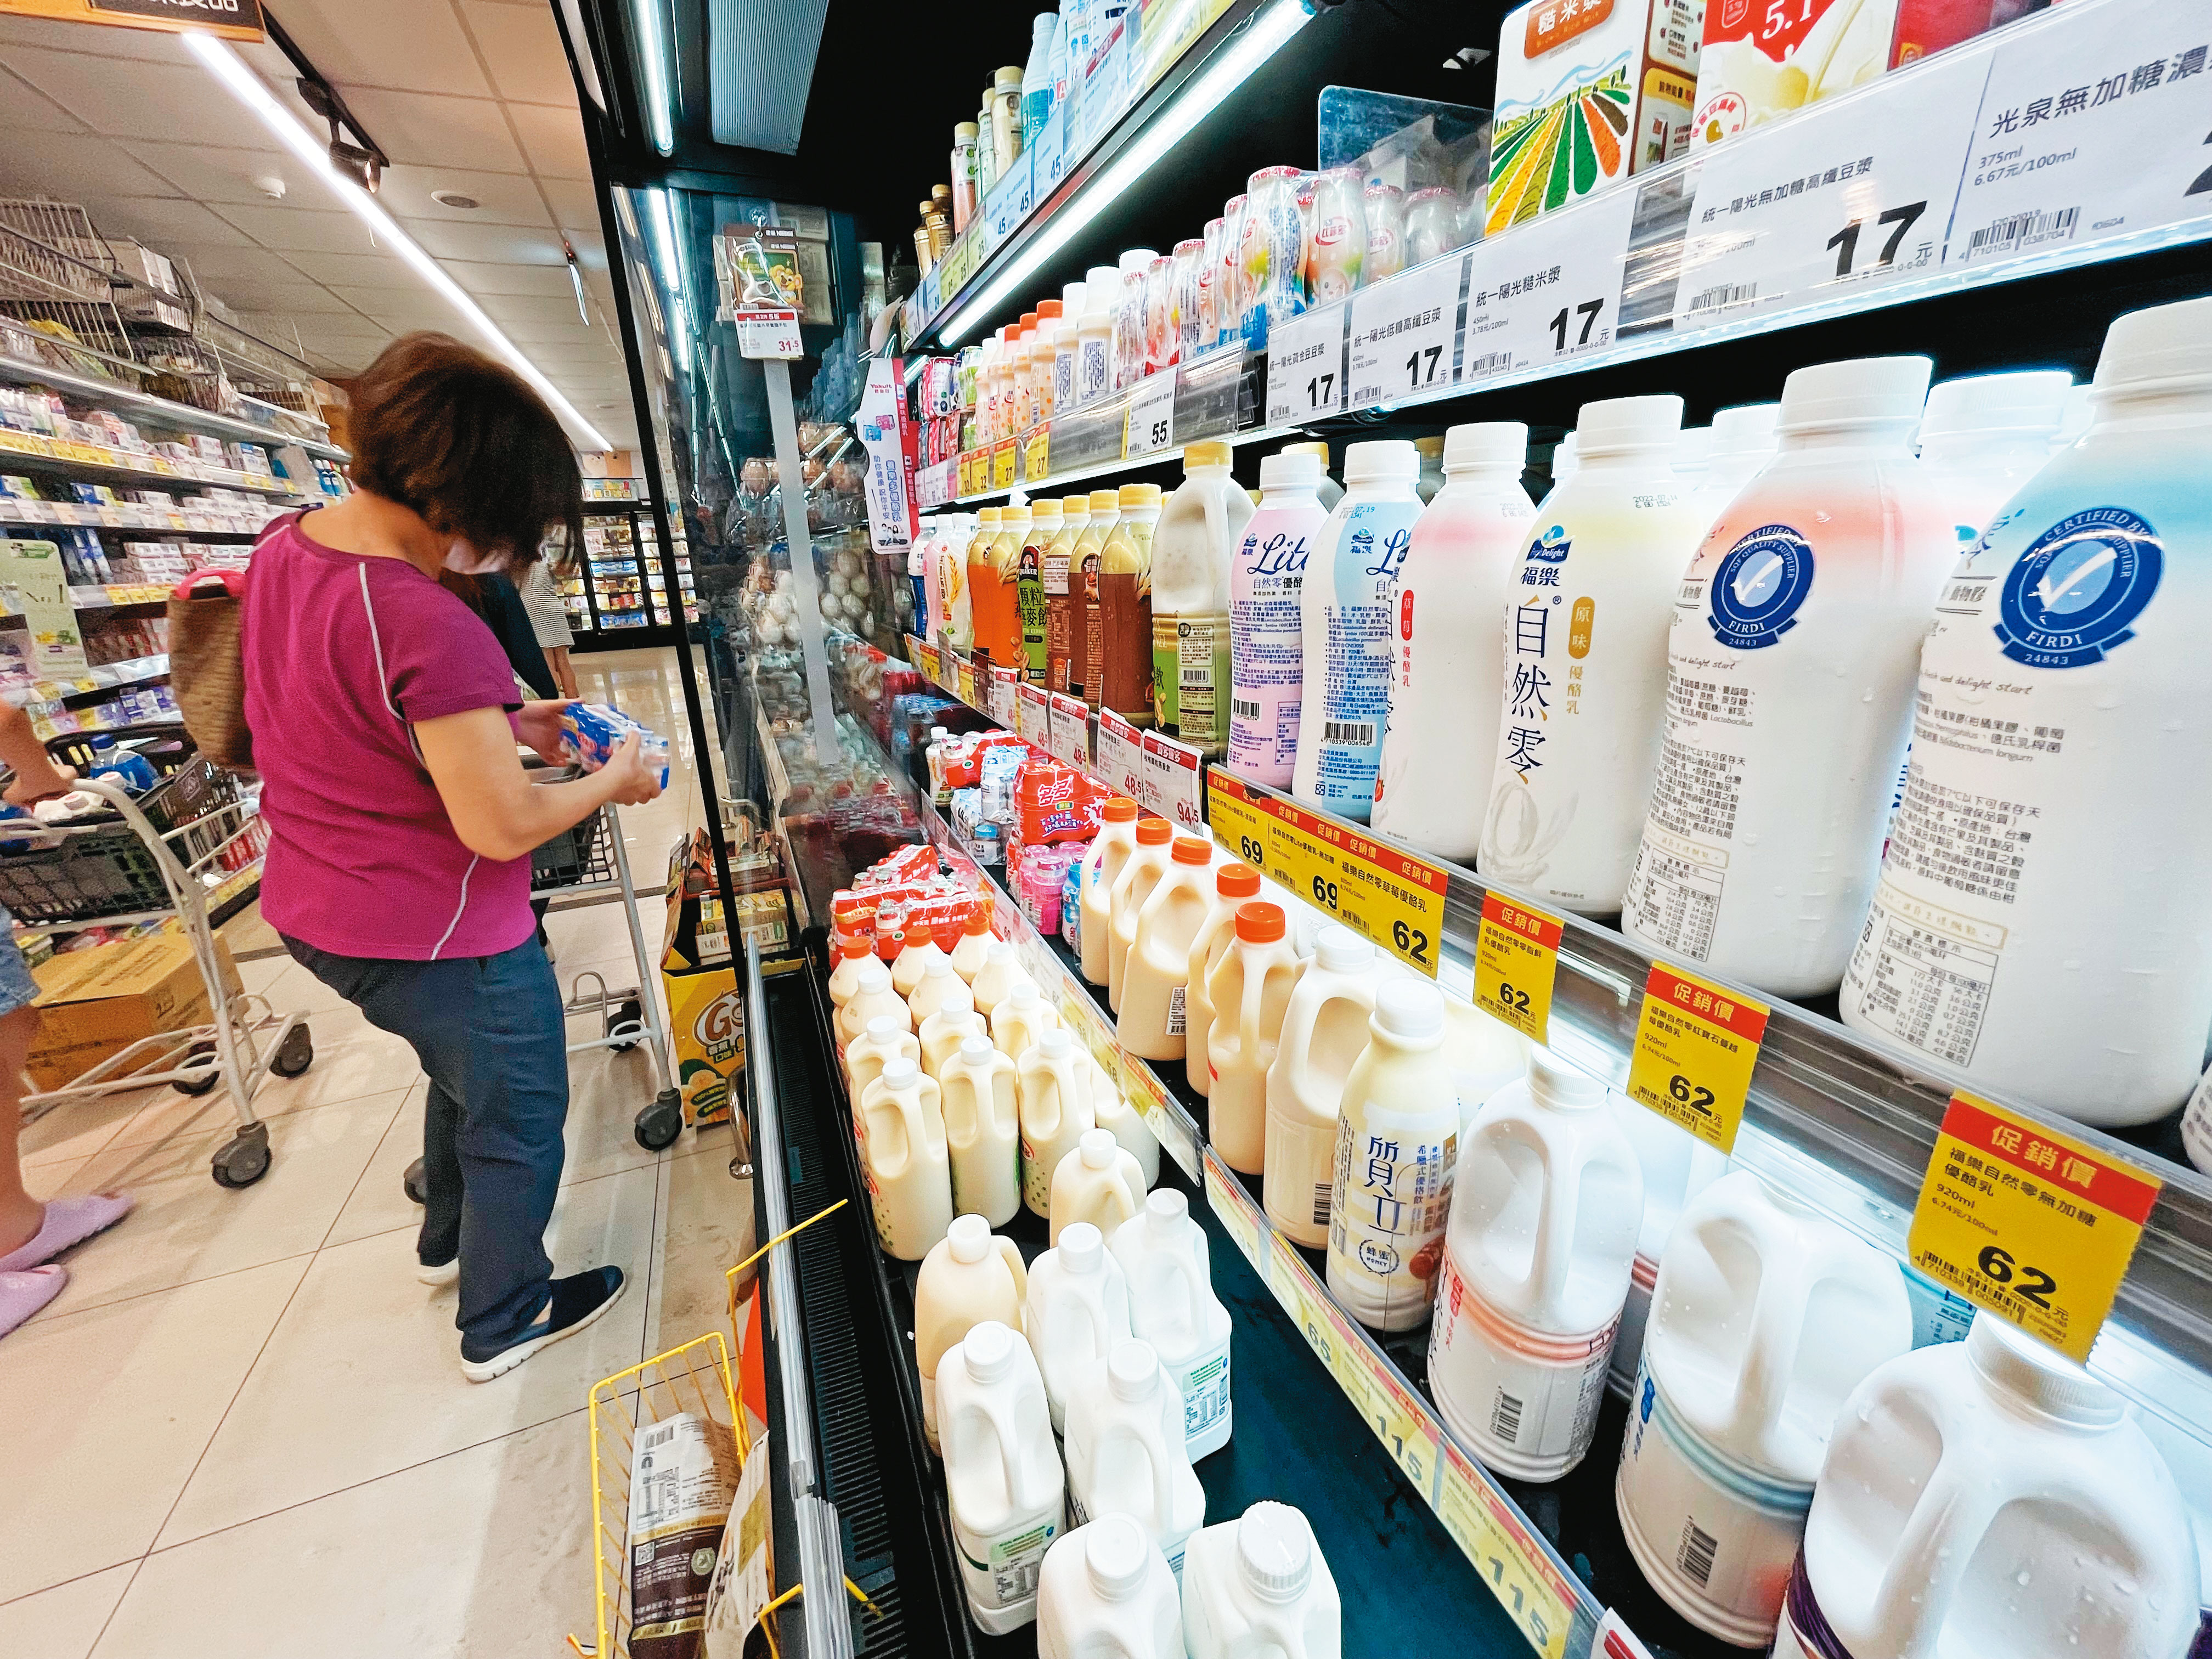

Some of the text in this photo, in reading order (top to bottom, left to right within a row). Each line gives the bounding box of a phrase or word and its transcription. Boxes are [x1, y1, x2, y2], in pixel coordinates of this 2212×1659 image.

[1989, 44, 2212, 138] 光泉無加糖濃
[1050, 155, 1061, 180] 45
[1974, 148, 2078, 186] 6.67元/100ml
[1978, 145, 2024, 169] 375ml
[1020, 190, 1029, 213] 45
[1701, 156, 1874, 223] 統一陽光無加糖高纖豆漿
[998, 217, 1006, 235] 45
[1826, 200, 1928, 276] 17
[1915, 241, 1933, 261] 元
[1476, 266, 1561, 307] 統一陽光糙米漿
[1549, 298, 1604, 350] 17
[1599, 328, 1610, 341] 元
[778, 340, 799, 352] 31.5
[1406, 345, 1443, 386] 17
[1307, 373, 1334, 407] 17
[1152, 420, 1168, 445] 55
[1005, 466, 1013, 482] 27
[1037, 456, 1046, 474] 27
[980, 475, 987, 490] 32
[2045, 511, 2129, 541] CERTIFIED
[1742, 541, 1779, 558] QUALITY
[1777, 543, 1796, 579] SUPPLIER
[2113, 537, 2132, 578] UPPLIER
[1520, 566, 1561, 586] 福樂
[1019, 586, 1044, 606] 顆粒
[1402, 595, 1412, 634] 草莓
[1728, 620, 1765, 633] FIRDI
[1573, 605, 1590, 651] 原味
[2026, 631, 2083, 648] FIRDI
[1729, 637, 1757, 647] 24843
[1402, 645, 1411, 688] 優酪乳
[1712, 661, 1735, 670] start
[2024, 653, 2069, 665] 24843
[1505, 595, 1551, 785] 自然零
[1566, 665, 1584, 715] 優酪乳
[1995, 684, 2033, 695] start
[1073, 747, 1086, 765] 48.5
[1038, 774, 1074, 807] 多多
[1125, 774, 1142, 795] 48.5
[1213, 775, 1229, 792] 促銷價
[1177, 802, 1199, 826] 94.5
[1278, 805, 1299, 823] 促銷價
[1317, 823, 1341, 843] 促銷價
[1241, 835, 1262, 865] 69
[1349, 837, 1377, 860] 促銷價
[1341, 860, 1427, 913] 福樂自然零草莓優酪乳
[1402, 861, 1432, 886] 促銷價
[1312, 876, 1338, 910] 69
[1501, 906, 1542, 936] 促銷價
[1392, 920, 1428, 964] 62
[1481, 950, 1497, 962] 920ml
[1499, 982, 1530, 1015] 62
[1673, 982, 1735, 1023] 促銷價
[1645, 1032, 1668, 1049] 920ml
[1641, 1043, 1681, 1068] 6.74元/100ml
[1669, 1074, 1716, 1117] 62
[1714, 1113, 1723, 1124] 元
[1991, 1124, 2097, 1189] 促銷價
[1944, 1163, 1995, 1198] 優酪乳
[1949, 1146, 2098, 1228] 福樂自然零無加糖
[1936, 1183, 1976, 1209] 920ml
[1931, 1197, 1999, 1237] 6.74元/100ml
[1237, 1232, 1255, 1262] 95
[1365, 1245, 1392, 1261] 蜂蜜
[1366, 1256, 1388, 1267] HONEY
[1978, 1245, 2057, 1310] 62
[2053, 1306, 2069, 1321] 元
[1308, 1321, 1332, 1363] 65
[1376, 1414, 1423, 1481] 115
[1488, 1556, 1548, 1646] 115
